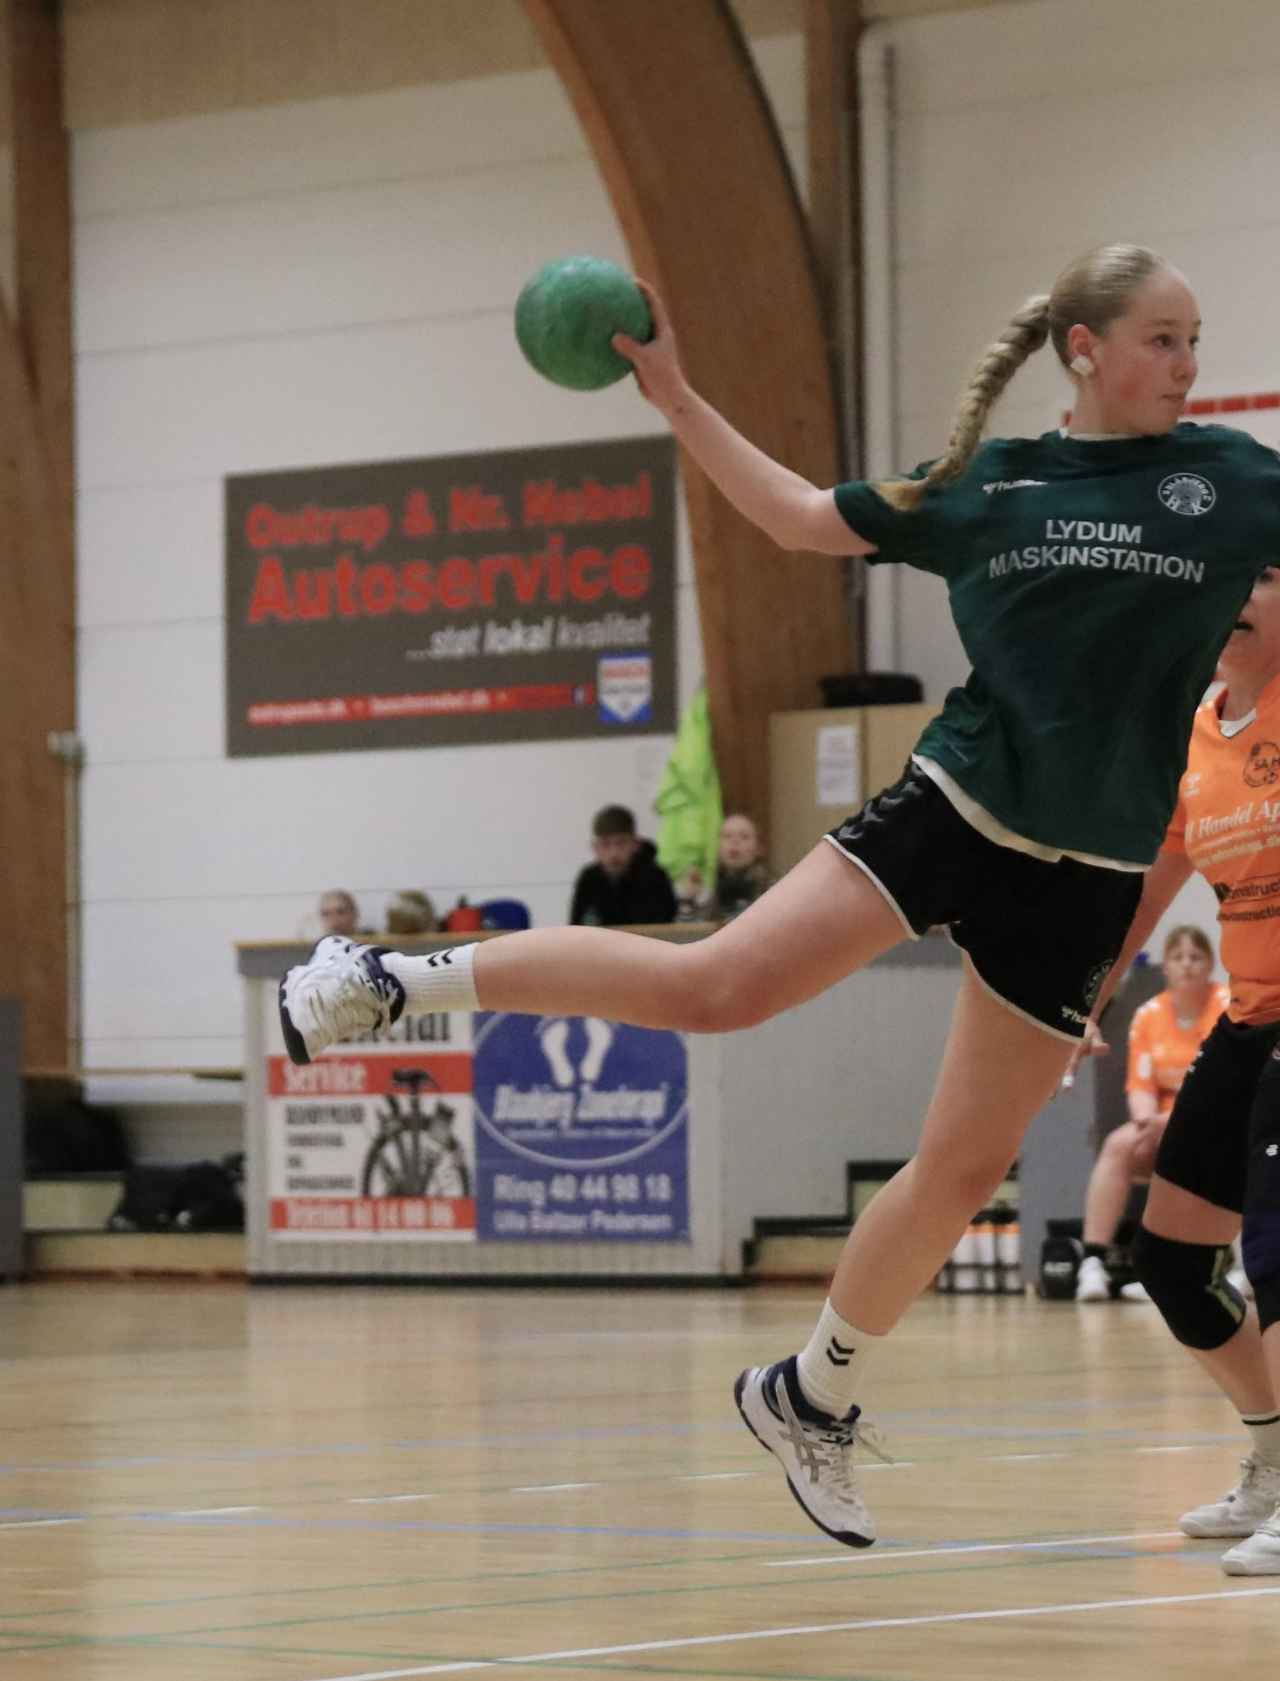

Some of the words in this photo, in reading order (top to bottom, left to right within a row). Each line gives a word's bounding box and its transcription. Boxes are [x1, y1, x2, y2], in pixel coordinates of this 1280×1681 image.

[403, 487, 434, 537] &
[1045, 519, 1142, 544] LYDUM
[246, 531, 652, 624] Autoservice
[988, 545, 1205, 583] MASKINSTATION
[494, 1173, 546, 1211] Ring
